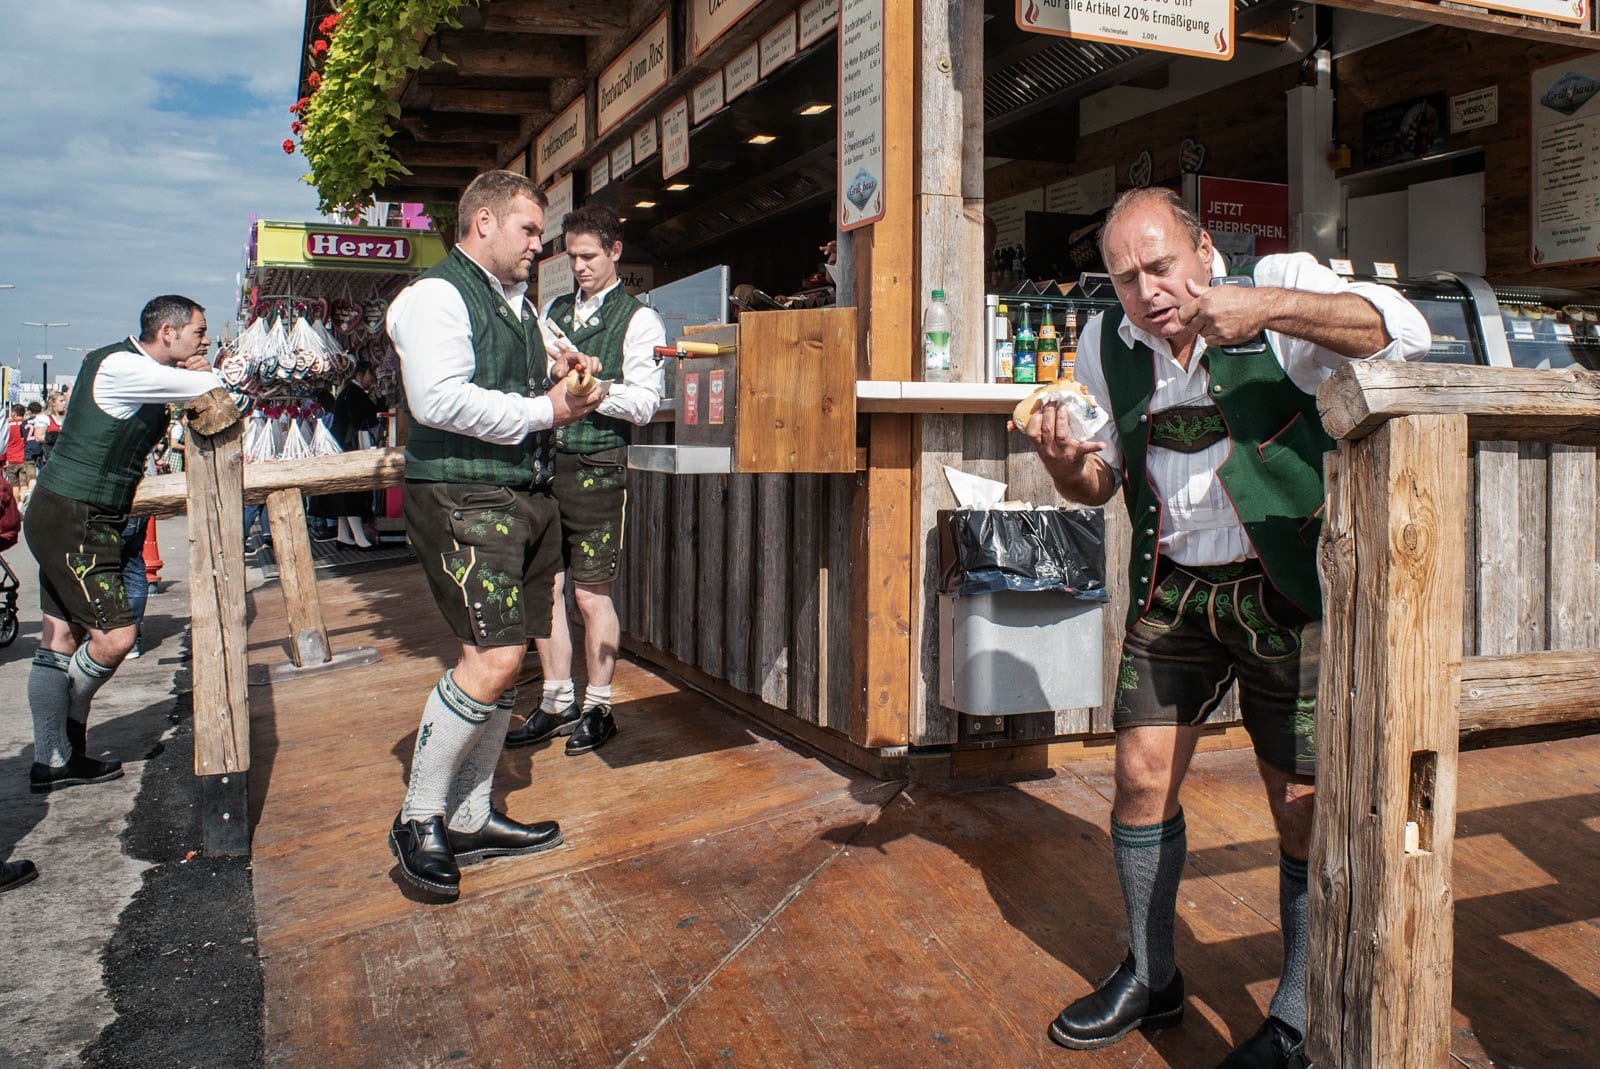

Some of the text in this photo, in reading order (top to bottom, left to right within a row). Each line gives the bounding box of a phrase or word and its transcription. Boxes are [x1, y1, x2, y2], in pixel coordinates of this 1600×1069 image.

[1064, 0, 1083, 11] alle
[1086, 0, 1120, 17] Artikel
[1123, 6, 1150, 22] 20%
[1153, 10, 1210, 34] Ermäßigung
[648, 36, 665, 72] Rost
[1462, 103, 1485, 116] VIDEO
[1207, 201, 1244, 216] JETZT
[312, 234, 405, 258] Herzl
